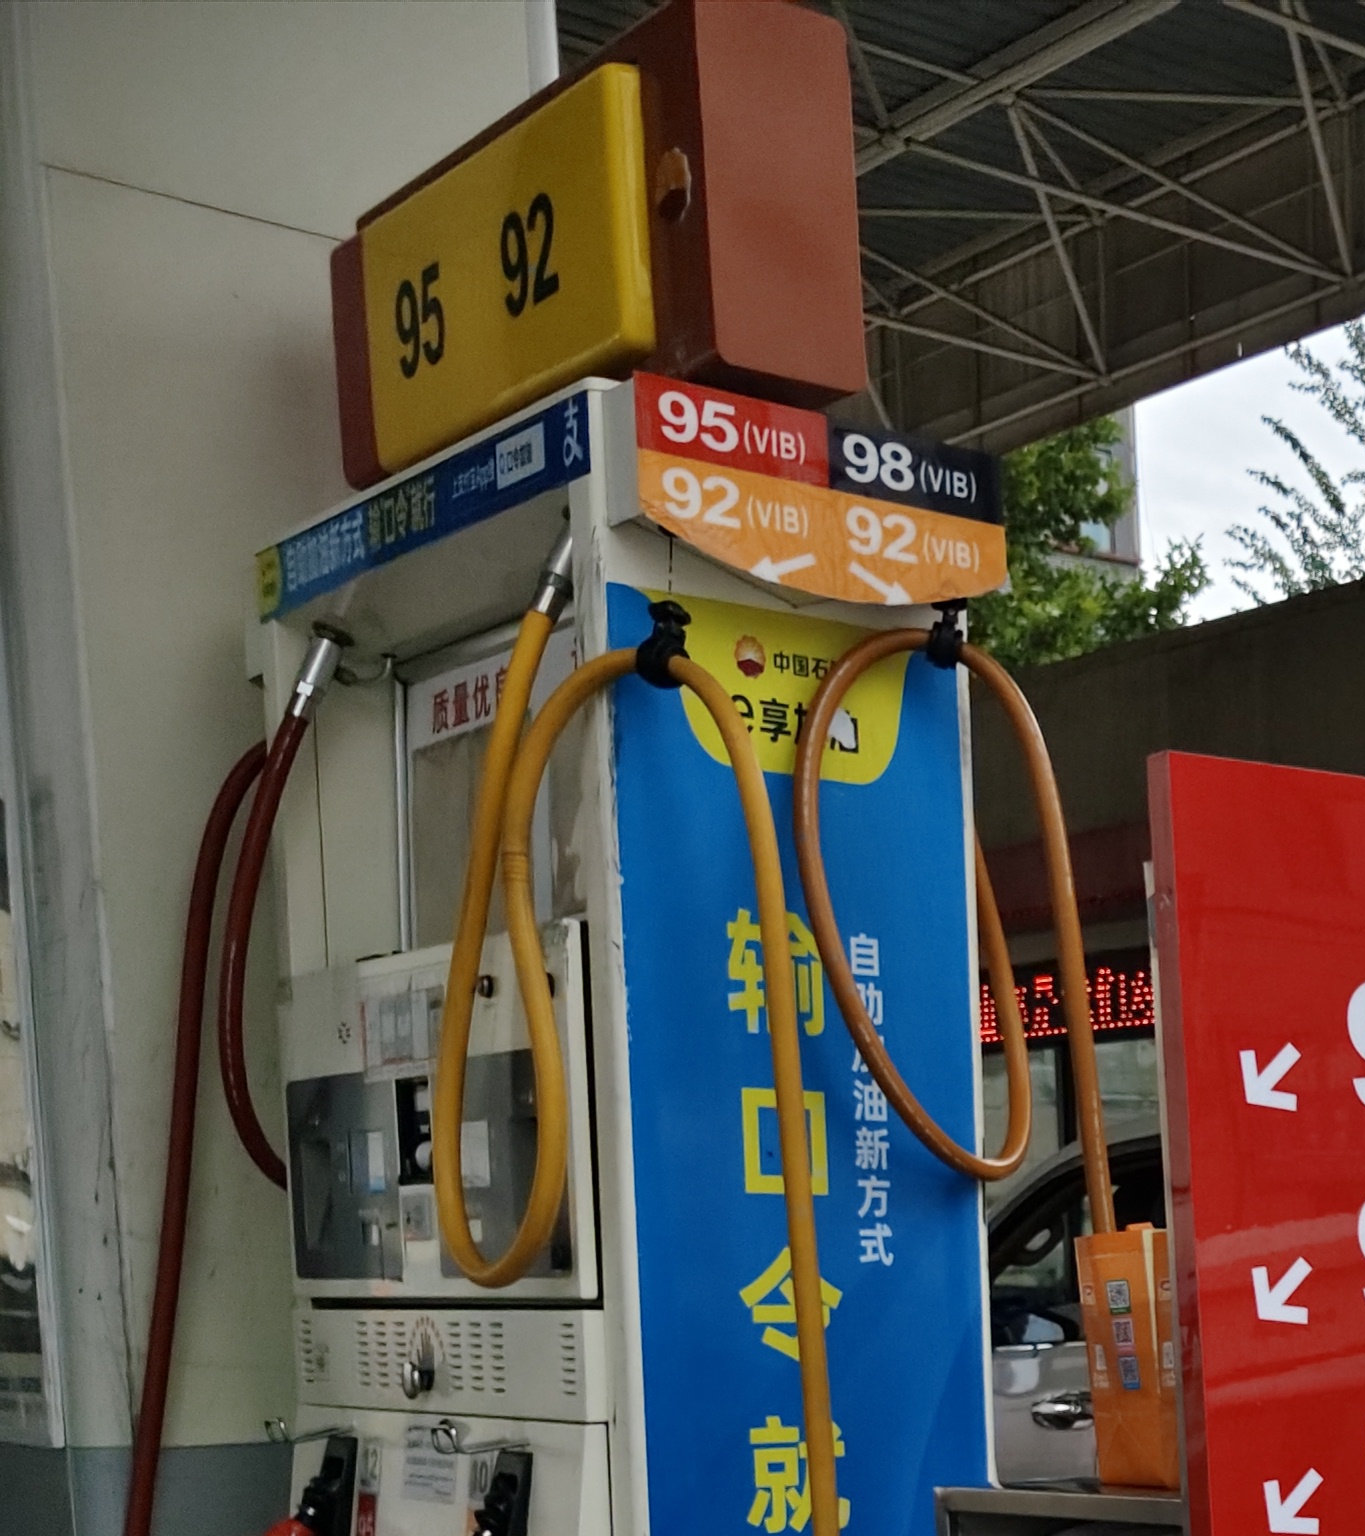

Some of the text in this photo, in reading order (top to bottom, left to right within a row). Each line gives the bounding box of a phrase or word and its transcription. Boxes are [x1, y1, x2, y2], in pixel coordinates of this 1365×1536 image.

[395, 193, 560, 379] 95 92
[773, 650, 836, 682] 中国石
